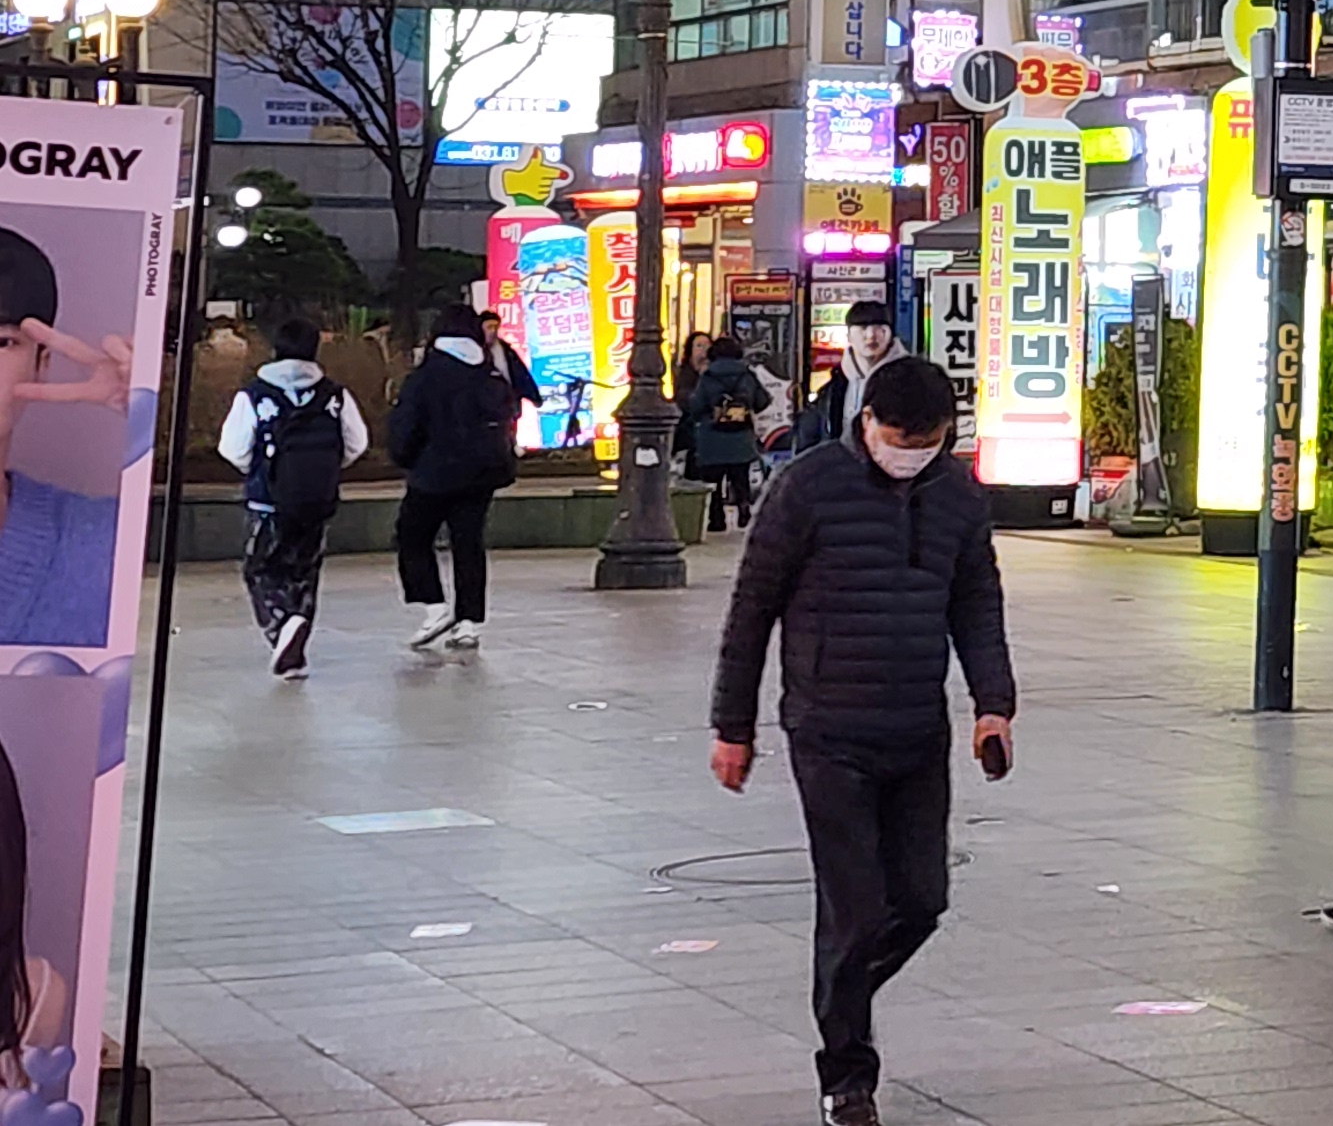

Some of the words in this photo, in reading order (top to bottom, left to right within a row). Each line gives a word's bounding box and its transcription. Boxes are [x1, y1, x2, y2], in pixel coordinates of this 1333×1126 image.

[1018, 57, 1086, 100] 3층
[1287, 97, 1315, 107] CCTV
[0, 140, 143, 181] GRAY
[1004, 138, 1081, 180] 애플
[144, 212, 164, 297] PHOTOGRAY
[1012, 187, 1070, 400] 노래방
[1277, 322, 1299, 430] CCTV
